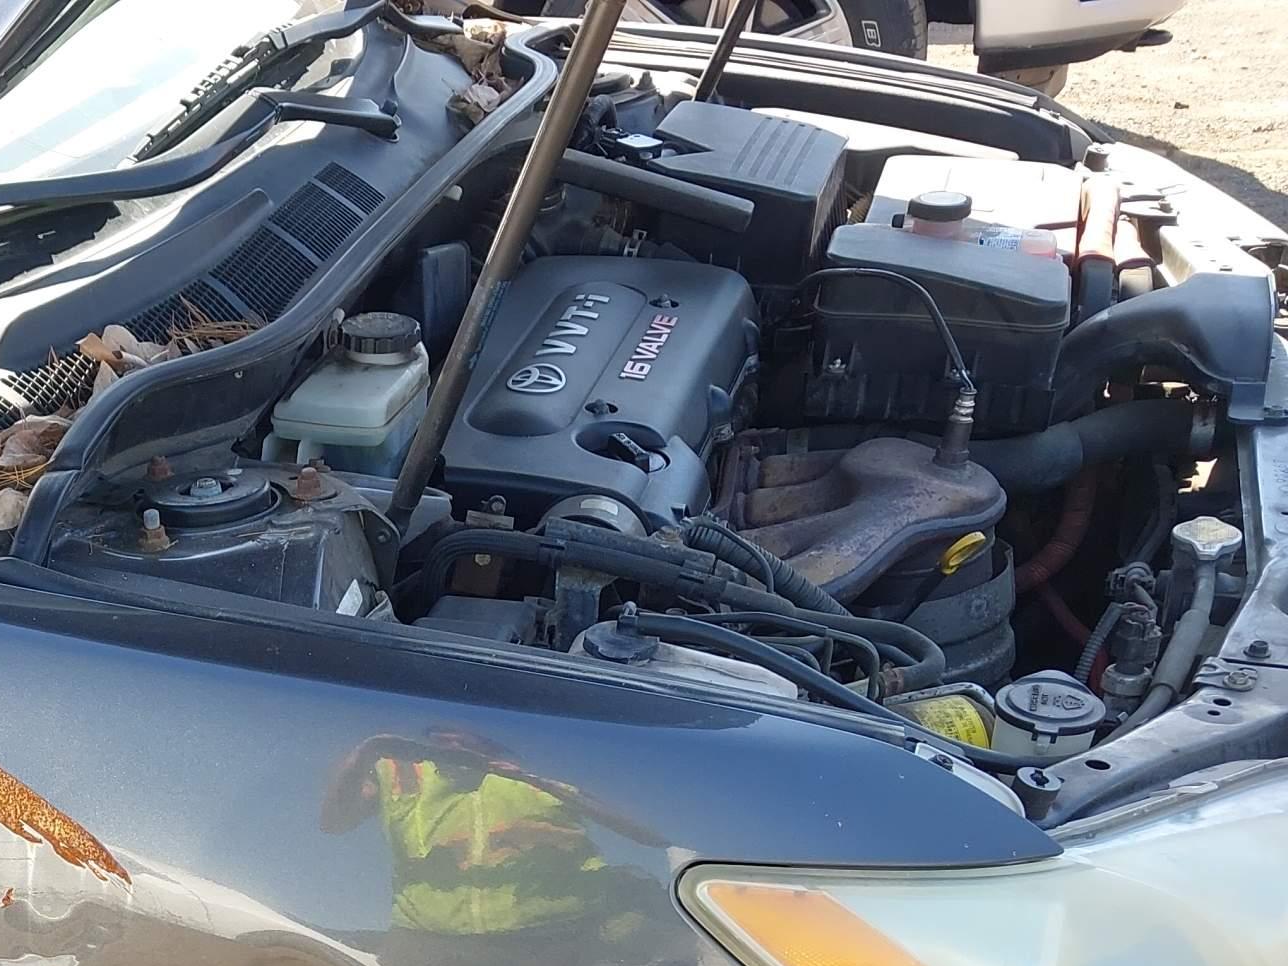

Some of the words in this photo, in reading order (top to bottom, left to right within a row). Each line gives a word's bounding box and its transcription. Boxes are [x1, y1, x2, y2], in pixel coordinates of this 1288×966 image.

[535, 293, 610, 356] VVT-i
[631, 313, 678, 361] VALVE
[618, 360, 651, 381] 16
